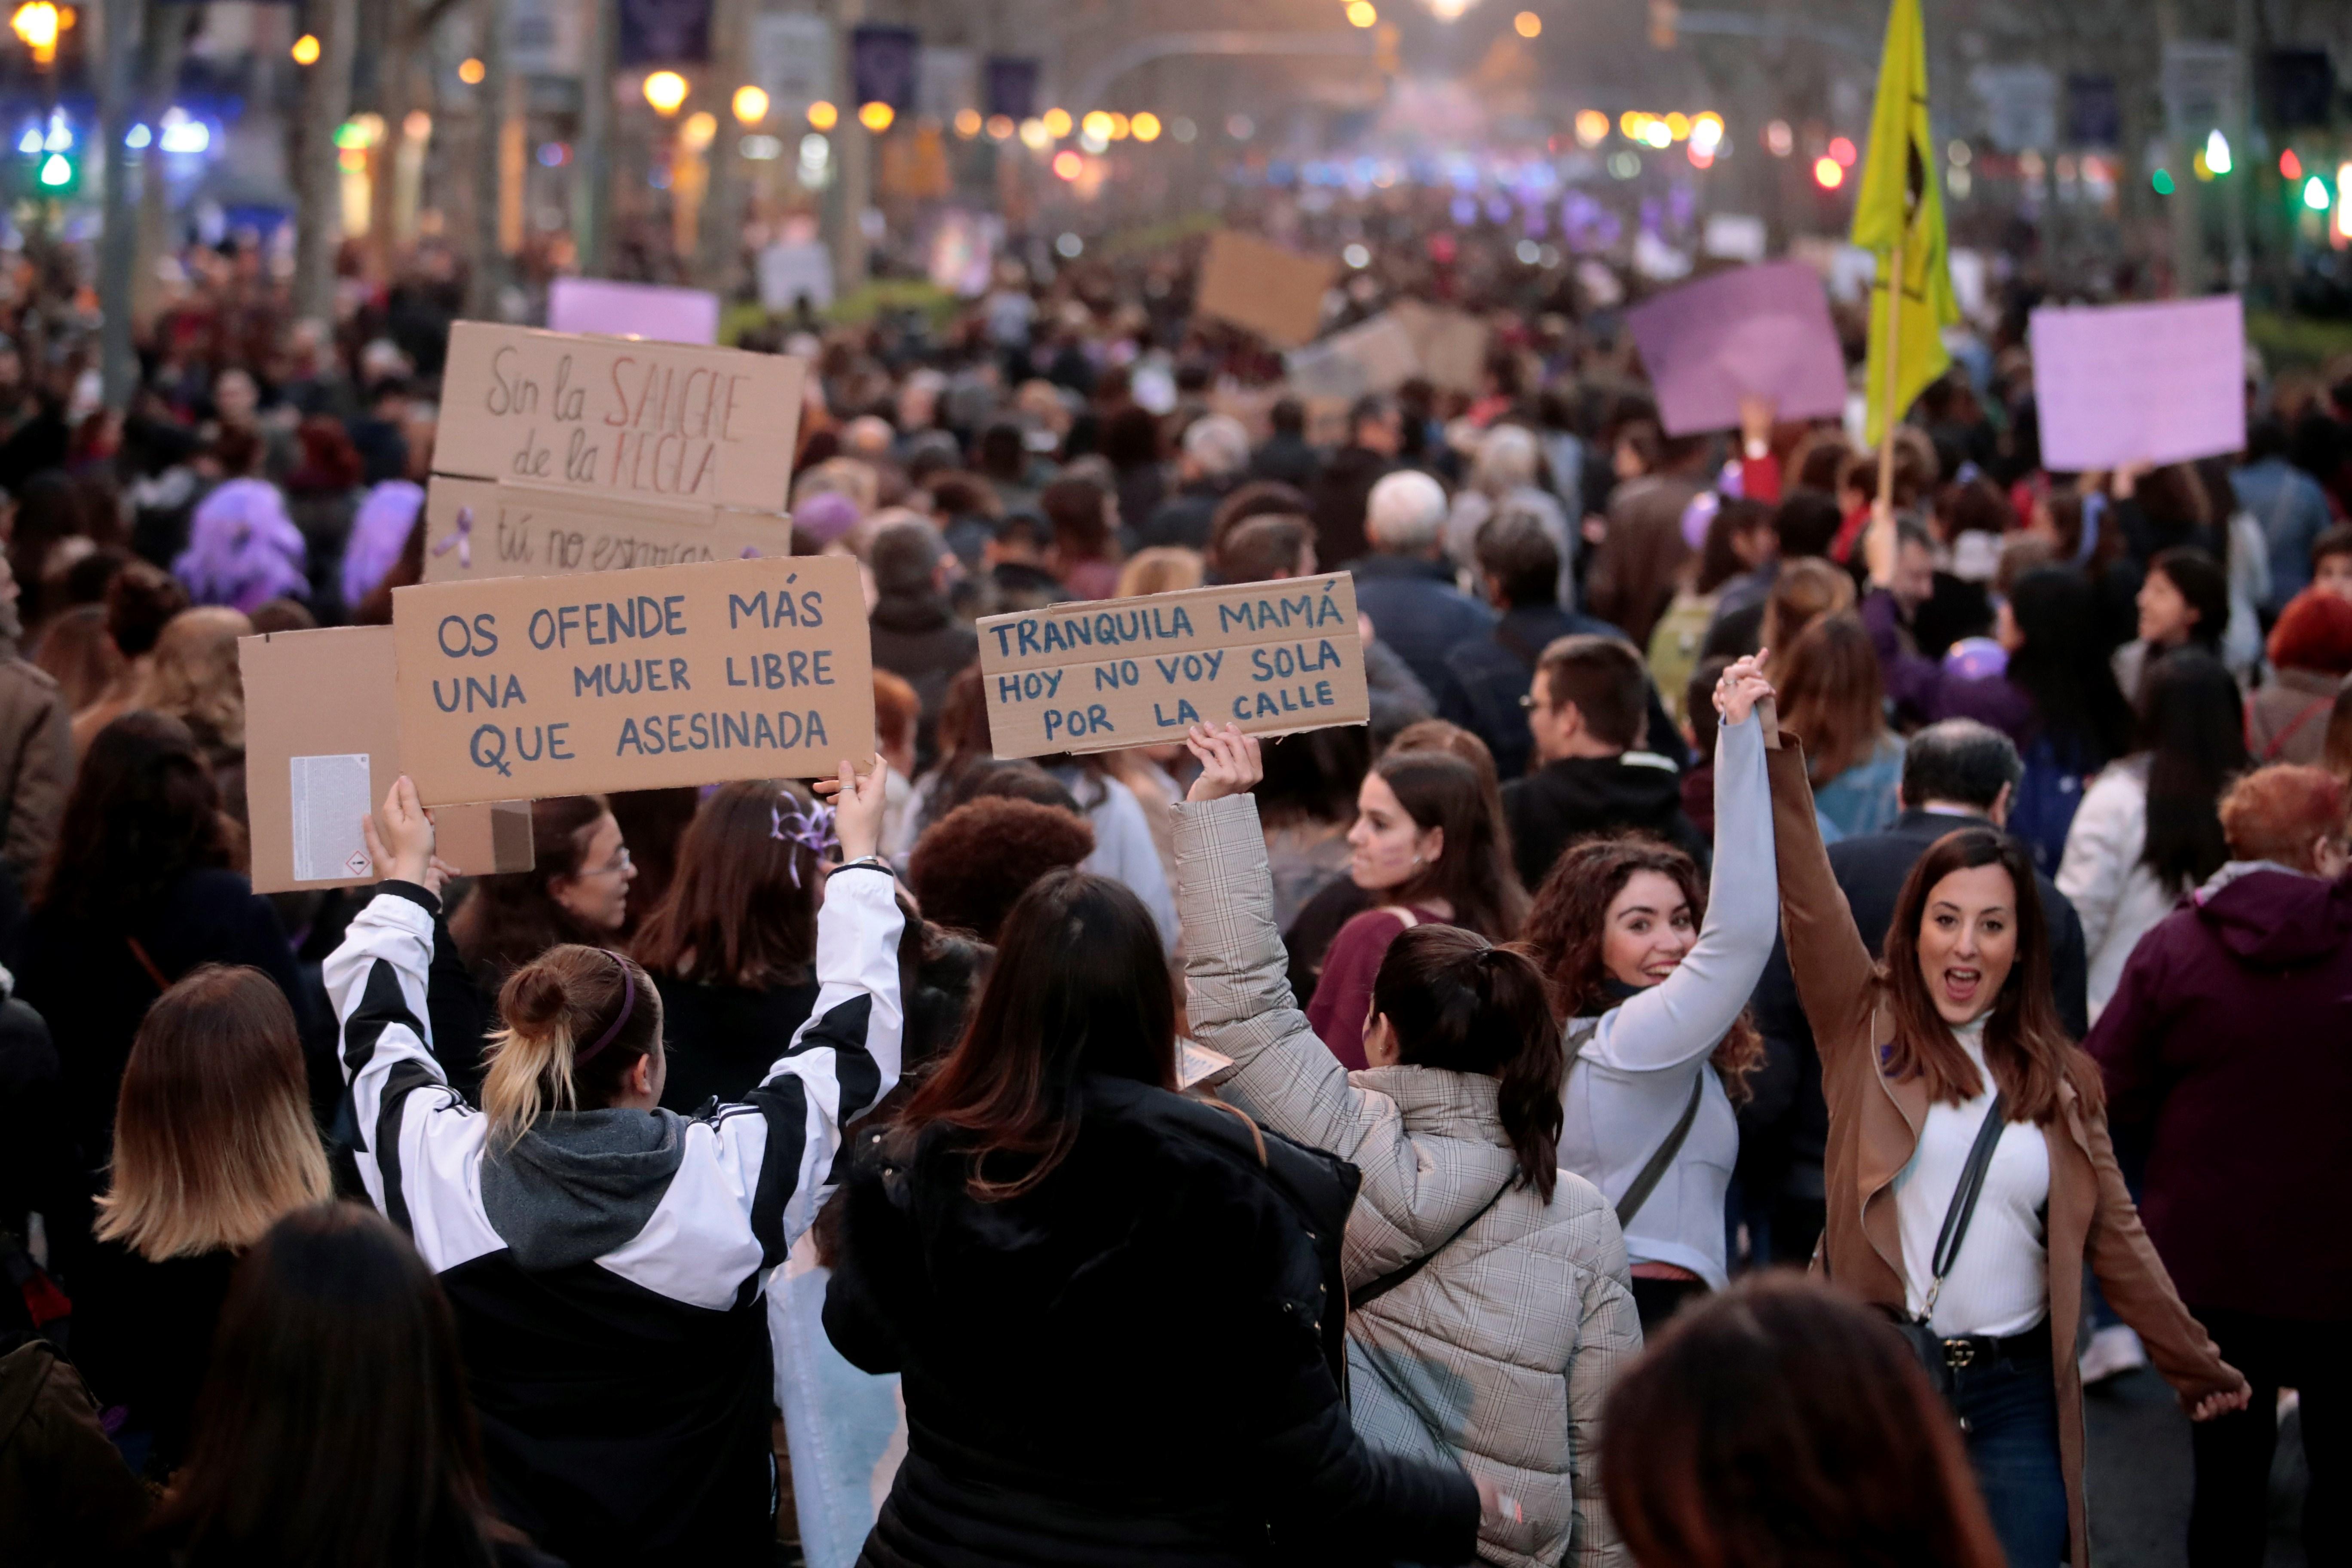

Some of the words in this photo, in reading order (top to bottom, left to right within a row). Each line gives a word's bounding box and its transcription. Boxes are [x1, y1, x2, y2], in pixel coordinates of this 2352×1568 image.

[487, 346, 539, 416] Sin
[554, 354, 585, 422] la
[514, 428, 551, 478] de
[565, 427, 599, 482] la
[497, 508, 533, 563] tú
[547, 528, 584, 569] no
[438, 614, 498, 658] OS
[529, 595, 687, 650] OFENDE
[729, 573, 822, 629] MÁS
[989, 606, 1194, 657] TRANQUILA
[1219, 579, 1344, 633] MAMÁ
[433, 674, 527, 712] UNA
[574, 658, 690, 697] MUJER
[726, 650, 835, 689] LIBRE
[999, 670, 1063, 703] HOY
[1095, 659, 1139, 691] NO
[1155, 649, 1224, 684] VOY
[1252, 640, 1341, 682] SOLA
[1044, 704, 1114, 740] POR
[1155, 699, 1199, 727] LA
[1232, 680, 1334, 720] CALLE
[470, 723, 575, 777] QUE
[617, 710, 827, 756] ASESINADA
